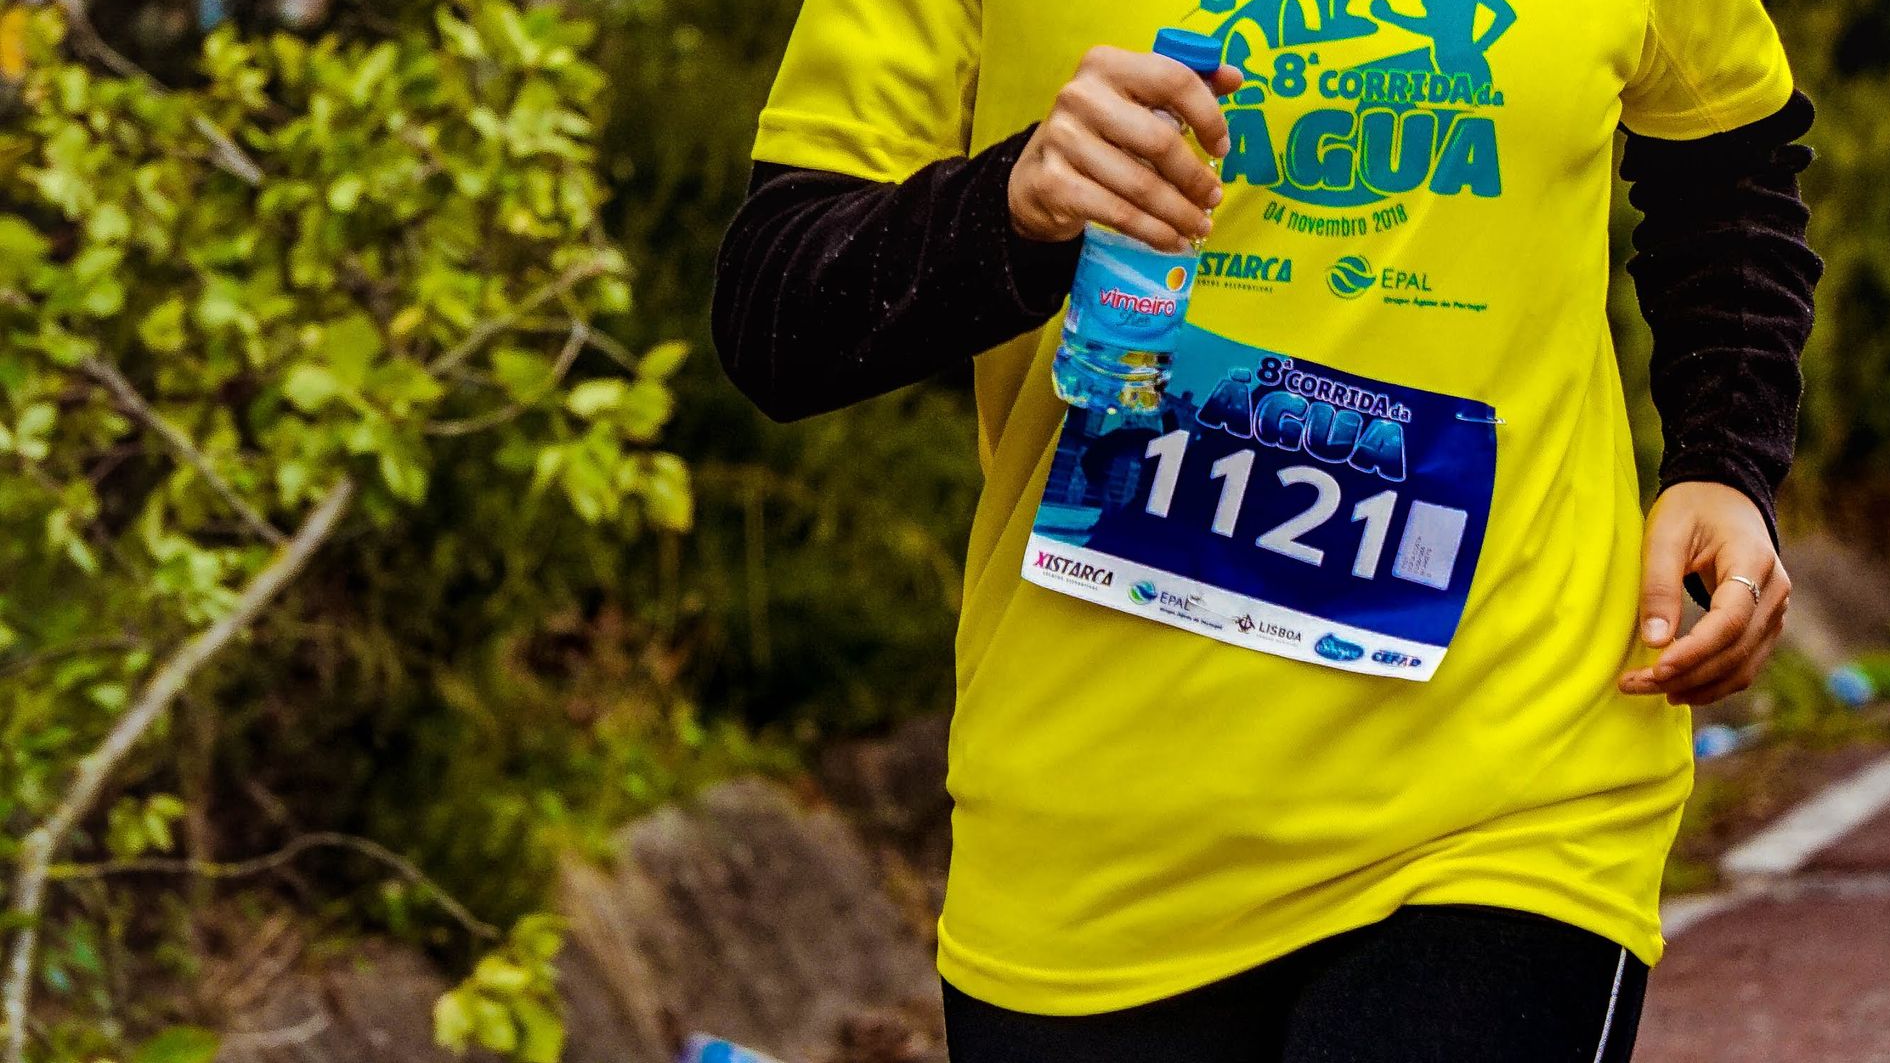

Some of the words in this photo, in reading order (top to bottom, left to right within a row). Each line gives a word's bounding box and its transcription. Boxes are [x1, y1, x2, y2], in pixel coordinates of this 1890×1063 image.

[1318, 69, 1475, 106] CORRIDA
[1220, 85, 1502, 198] ÁGUA
[1262, 201, 1286, 224] 04
[1286, 211, 1368, 237] novembro
[1198, 250, 1293, 283] STARCA
[1381, 267, 1433, 292] EPAL
[1100, 287, 1177, 317] vimeiro
[1284, 369, 1391, 419] CORRIDA
[1388, 403, 1412, 423] da
[1195, 366, 1407, 482] ÁGUA
[1144, 429, 1398, 580] 1121
[1033, 550, 1114, 588] XISTARCA
[1159, 591, 1191, 611] EPAL
[1258, 620, 1302, 643] LISBOA
